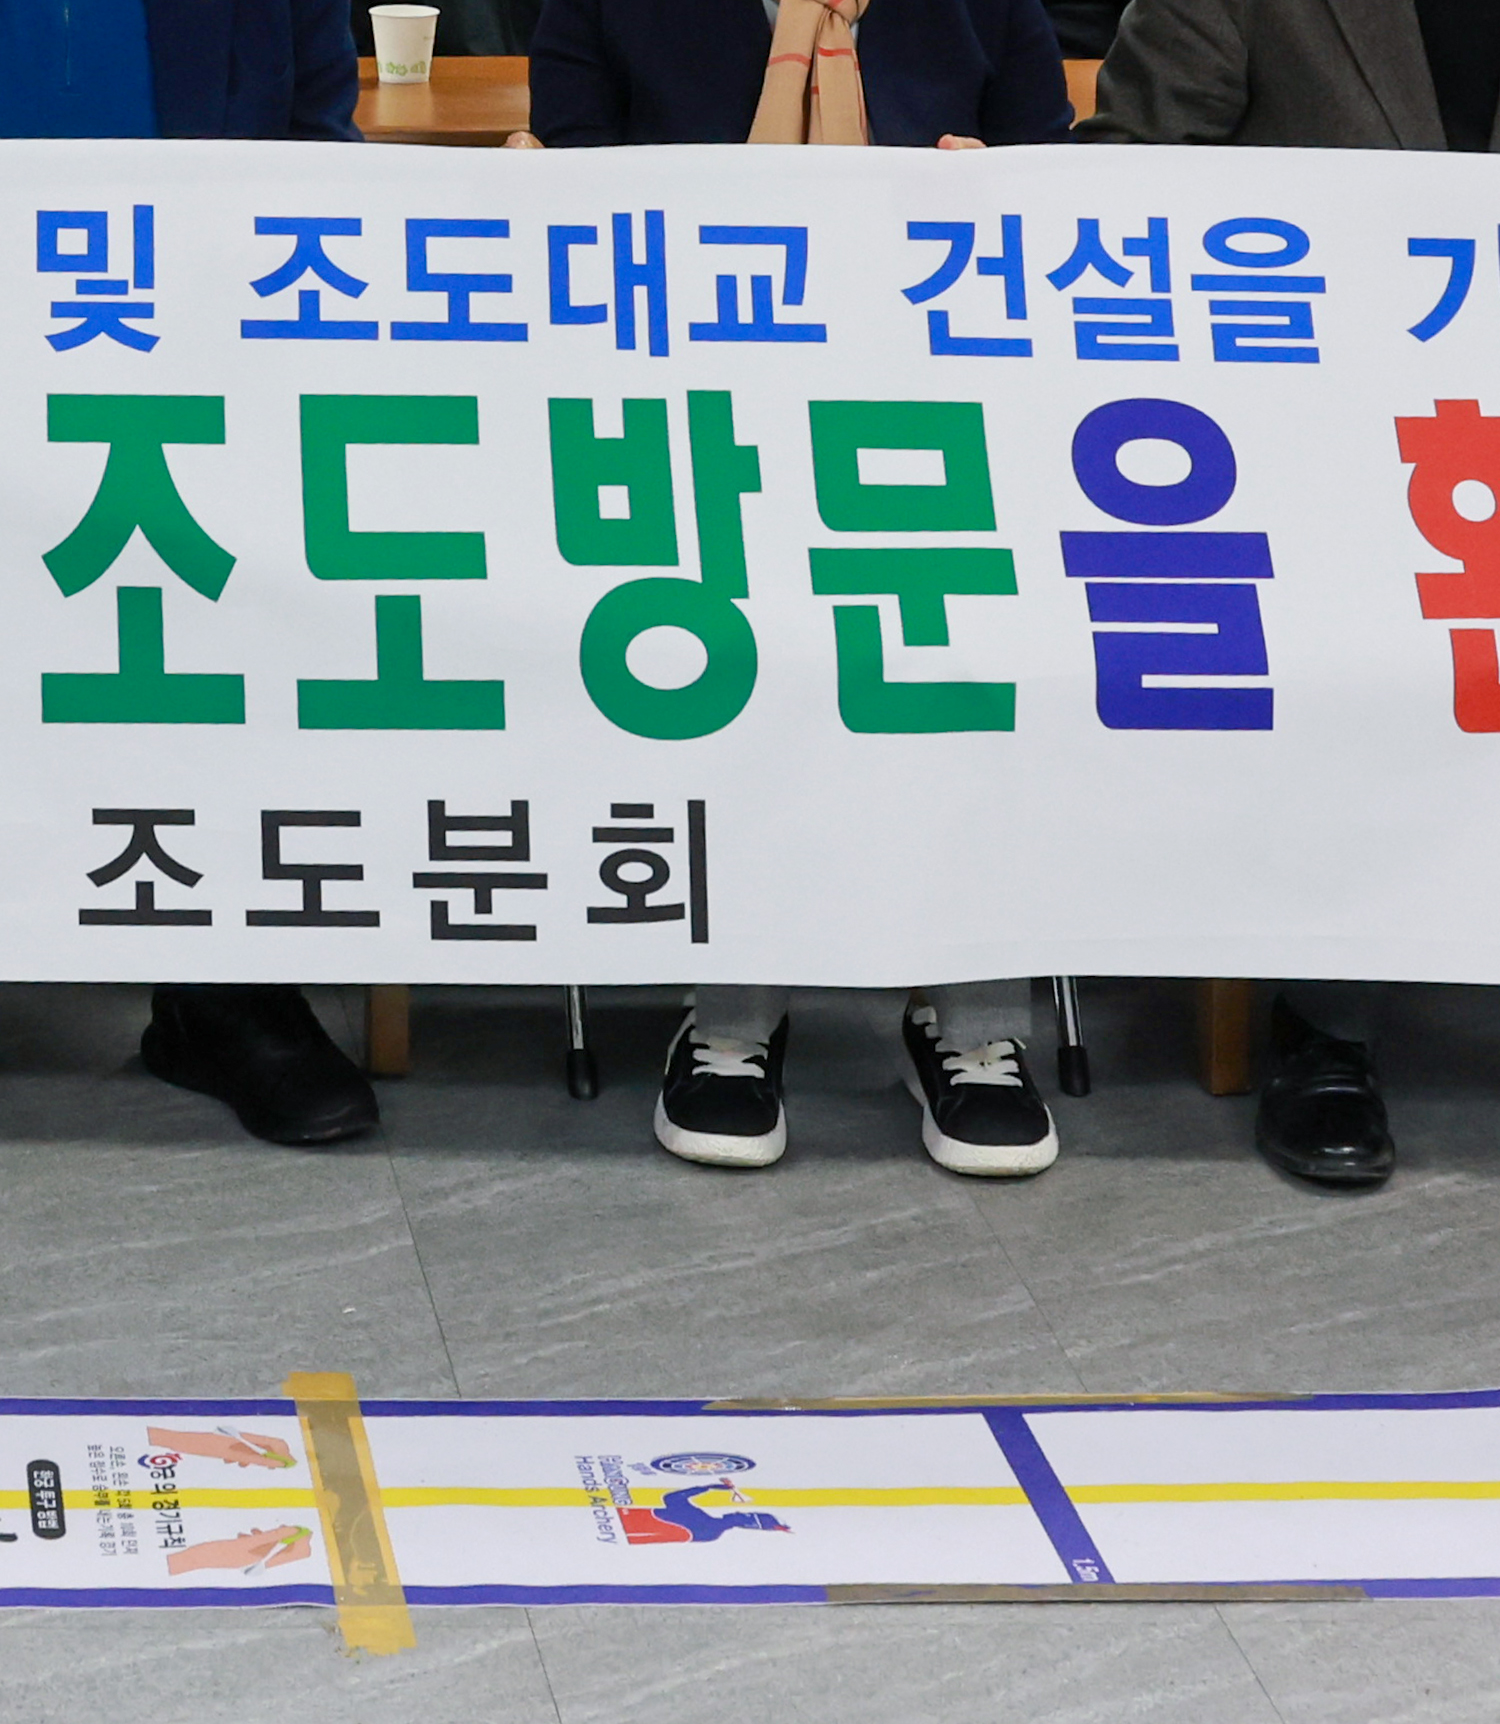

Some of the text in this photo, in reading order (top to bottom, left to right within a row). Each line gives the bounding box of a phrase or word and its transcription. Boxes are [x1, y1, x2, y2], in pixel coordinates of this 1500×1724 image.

[37, 205, 158, 352] 및
[241, 209, 827, 358] 조도대교
[904, 214, 1326, 364] 건설을
[41, 390, 1273, 741] 조도방문을
[78, 800, 709, 944] 조도분회
[33, 1470, 59, 1530] 한궁 투구 방법
[152, 1499, 187, 1549] 경기규칙
[574, 1455, 618, 1545] Hands Archery
